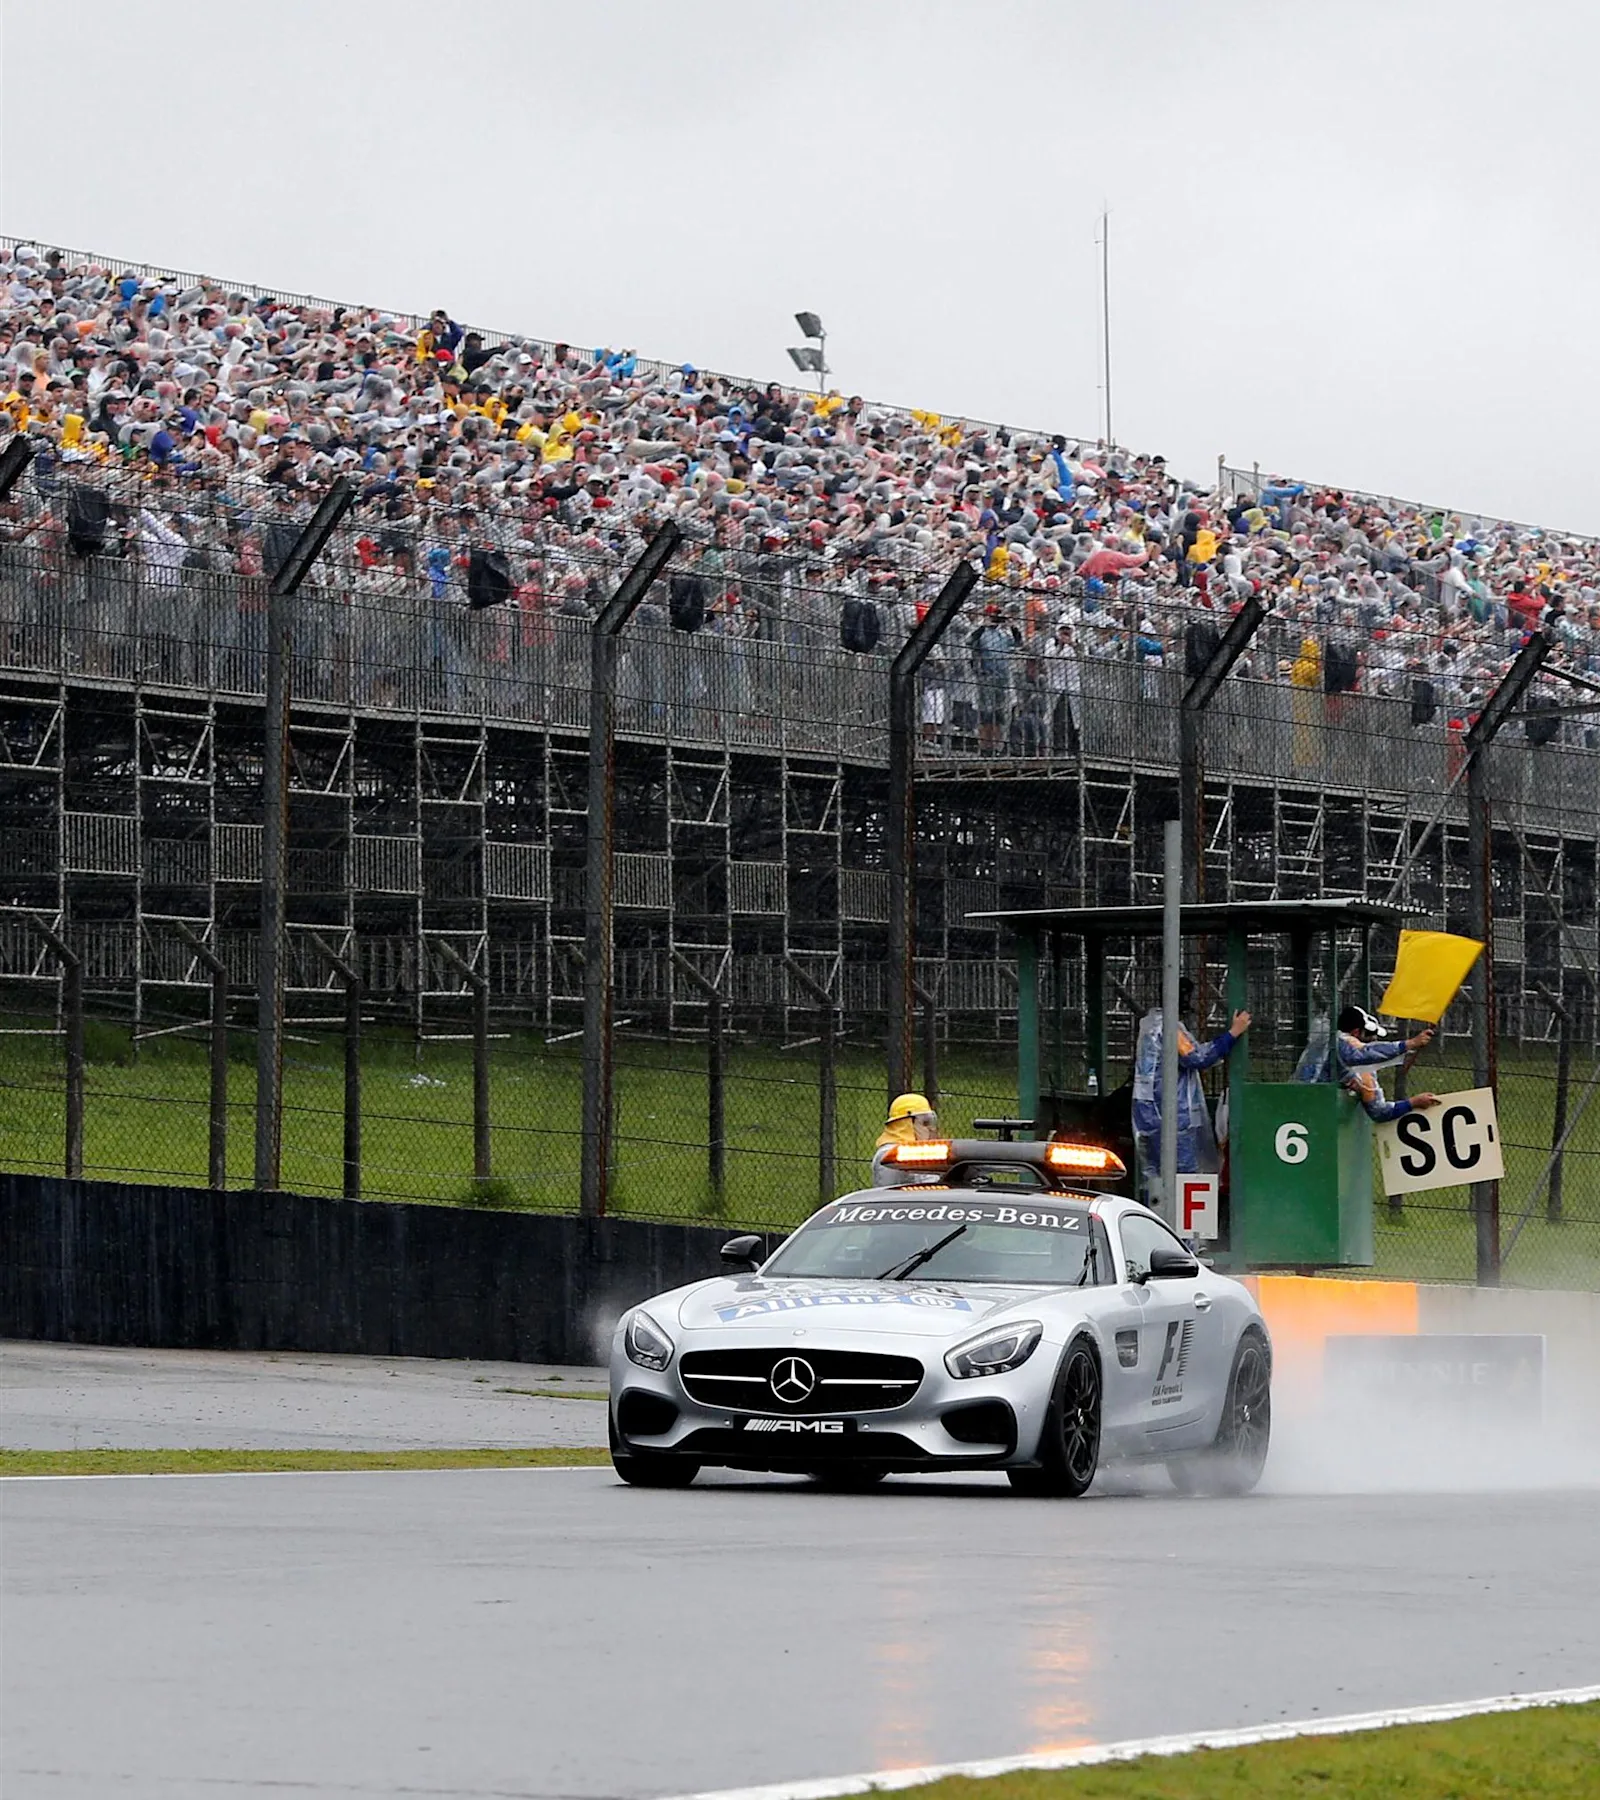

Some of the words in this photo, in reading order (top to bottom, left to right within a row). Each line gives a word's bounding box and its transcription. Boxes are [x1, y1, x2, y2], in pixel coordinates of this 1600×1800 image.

[1274, 1122, 1309, 1164] 6
[1397, 1106, 1481, 1176] SC
[826, 1205, 1081, 1231] Mercedes-Benz
[1183, 1182, 1211, 1230] F
[731, 1294, 902, 1319] Allianz
[771, 1419, 844, 1433] AMG
